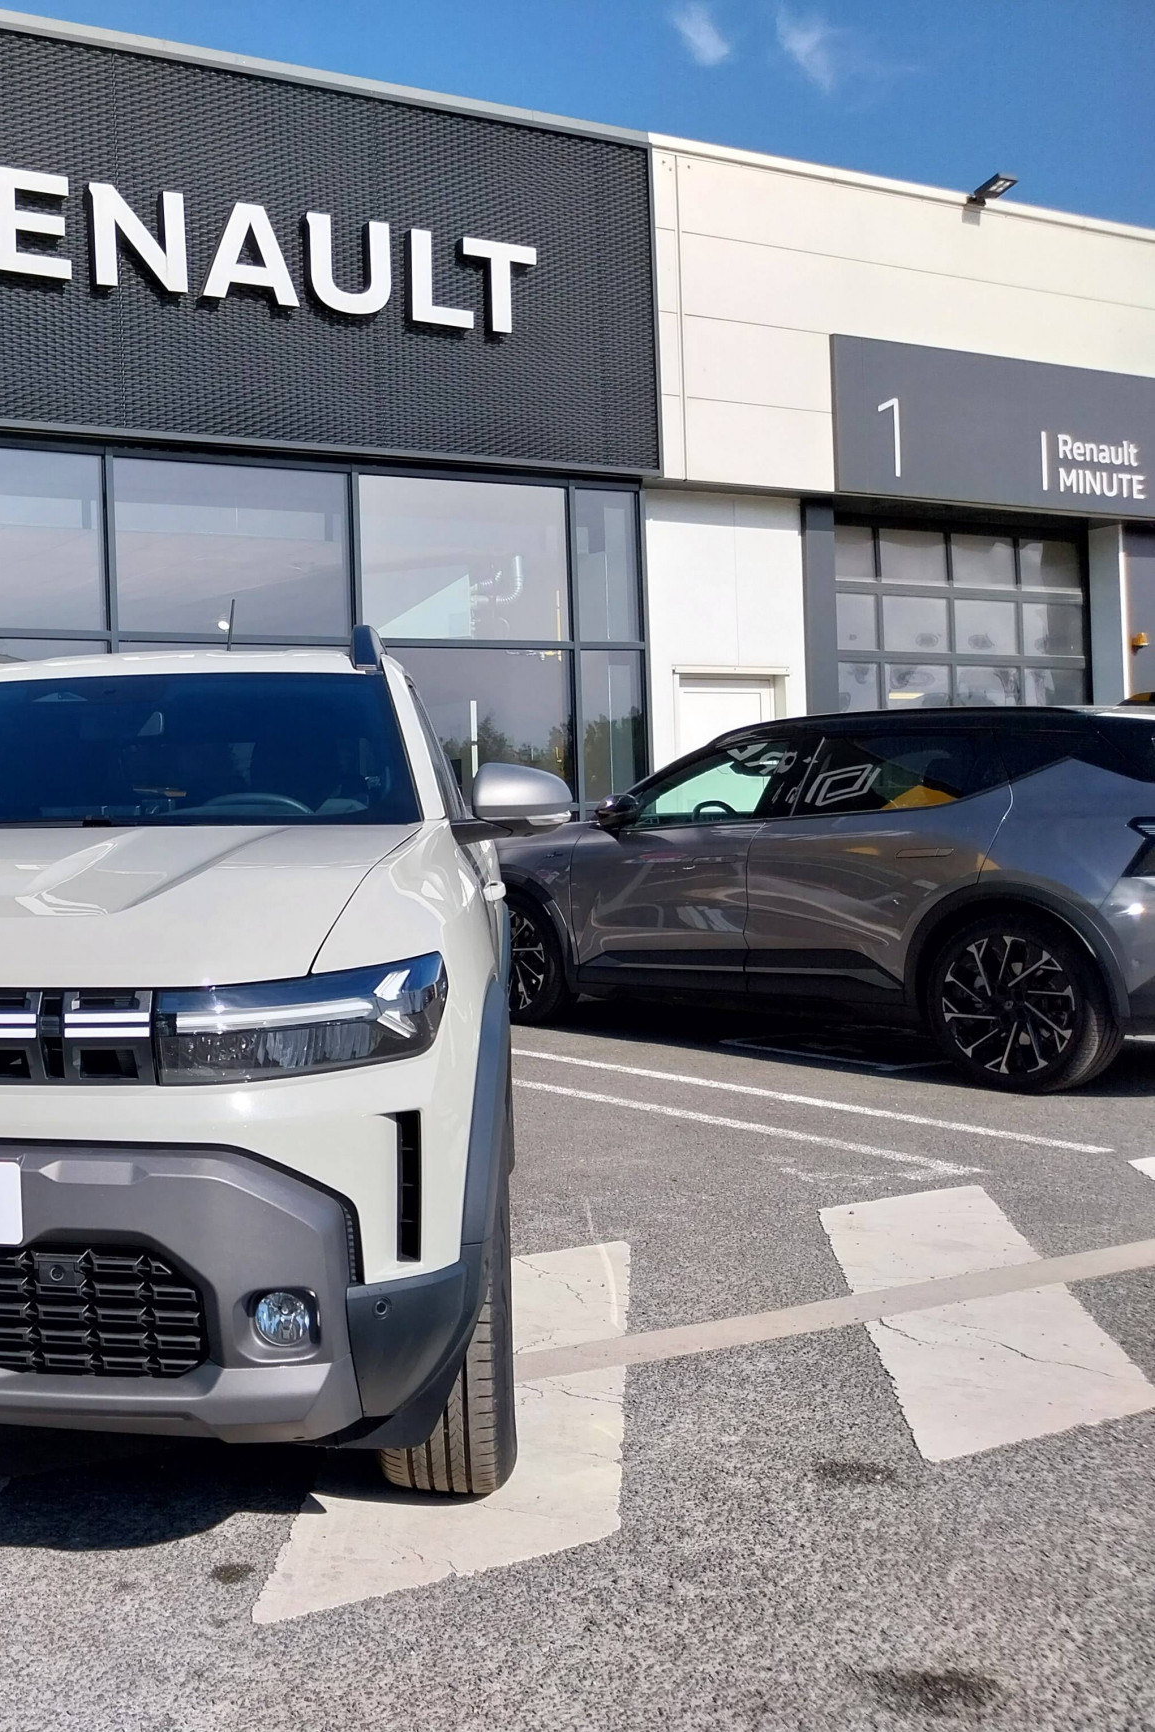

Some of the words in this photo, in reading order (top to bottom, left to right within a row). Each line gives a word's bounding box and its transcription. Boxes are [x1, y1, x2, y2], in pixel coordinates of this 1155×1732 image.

[877, 397, 901, 478] 1
[1057, 433, 1140, 467] Renault
[1059, 467, 1146, 499] MINUTE
